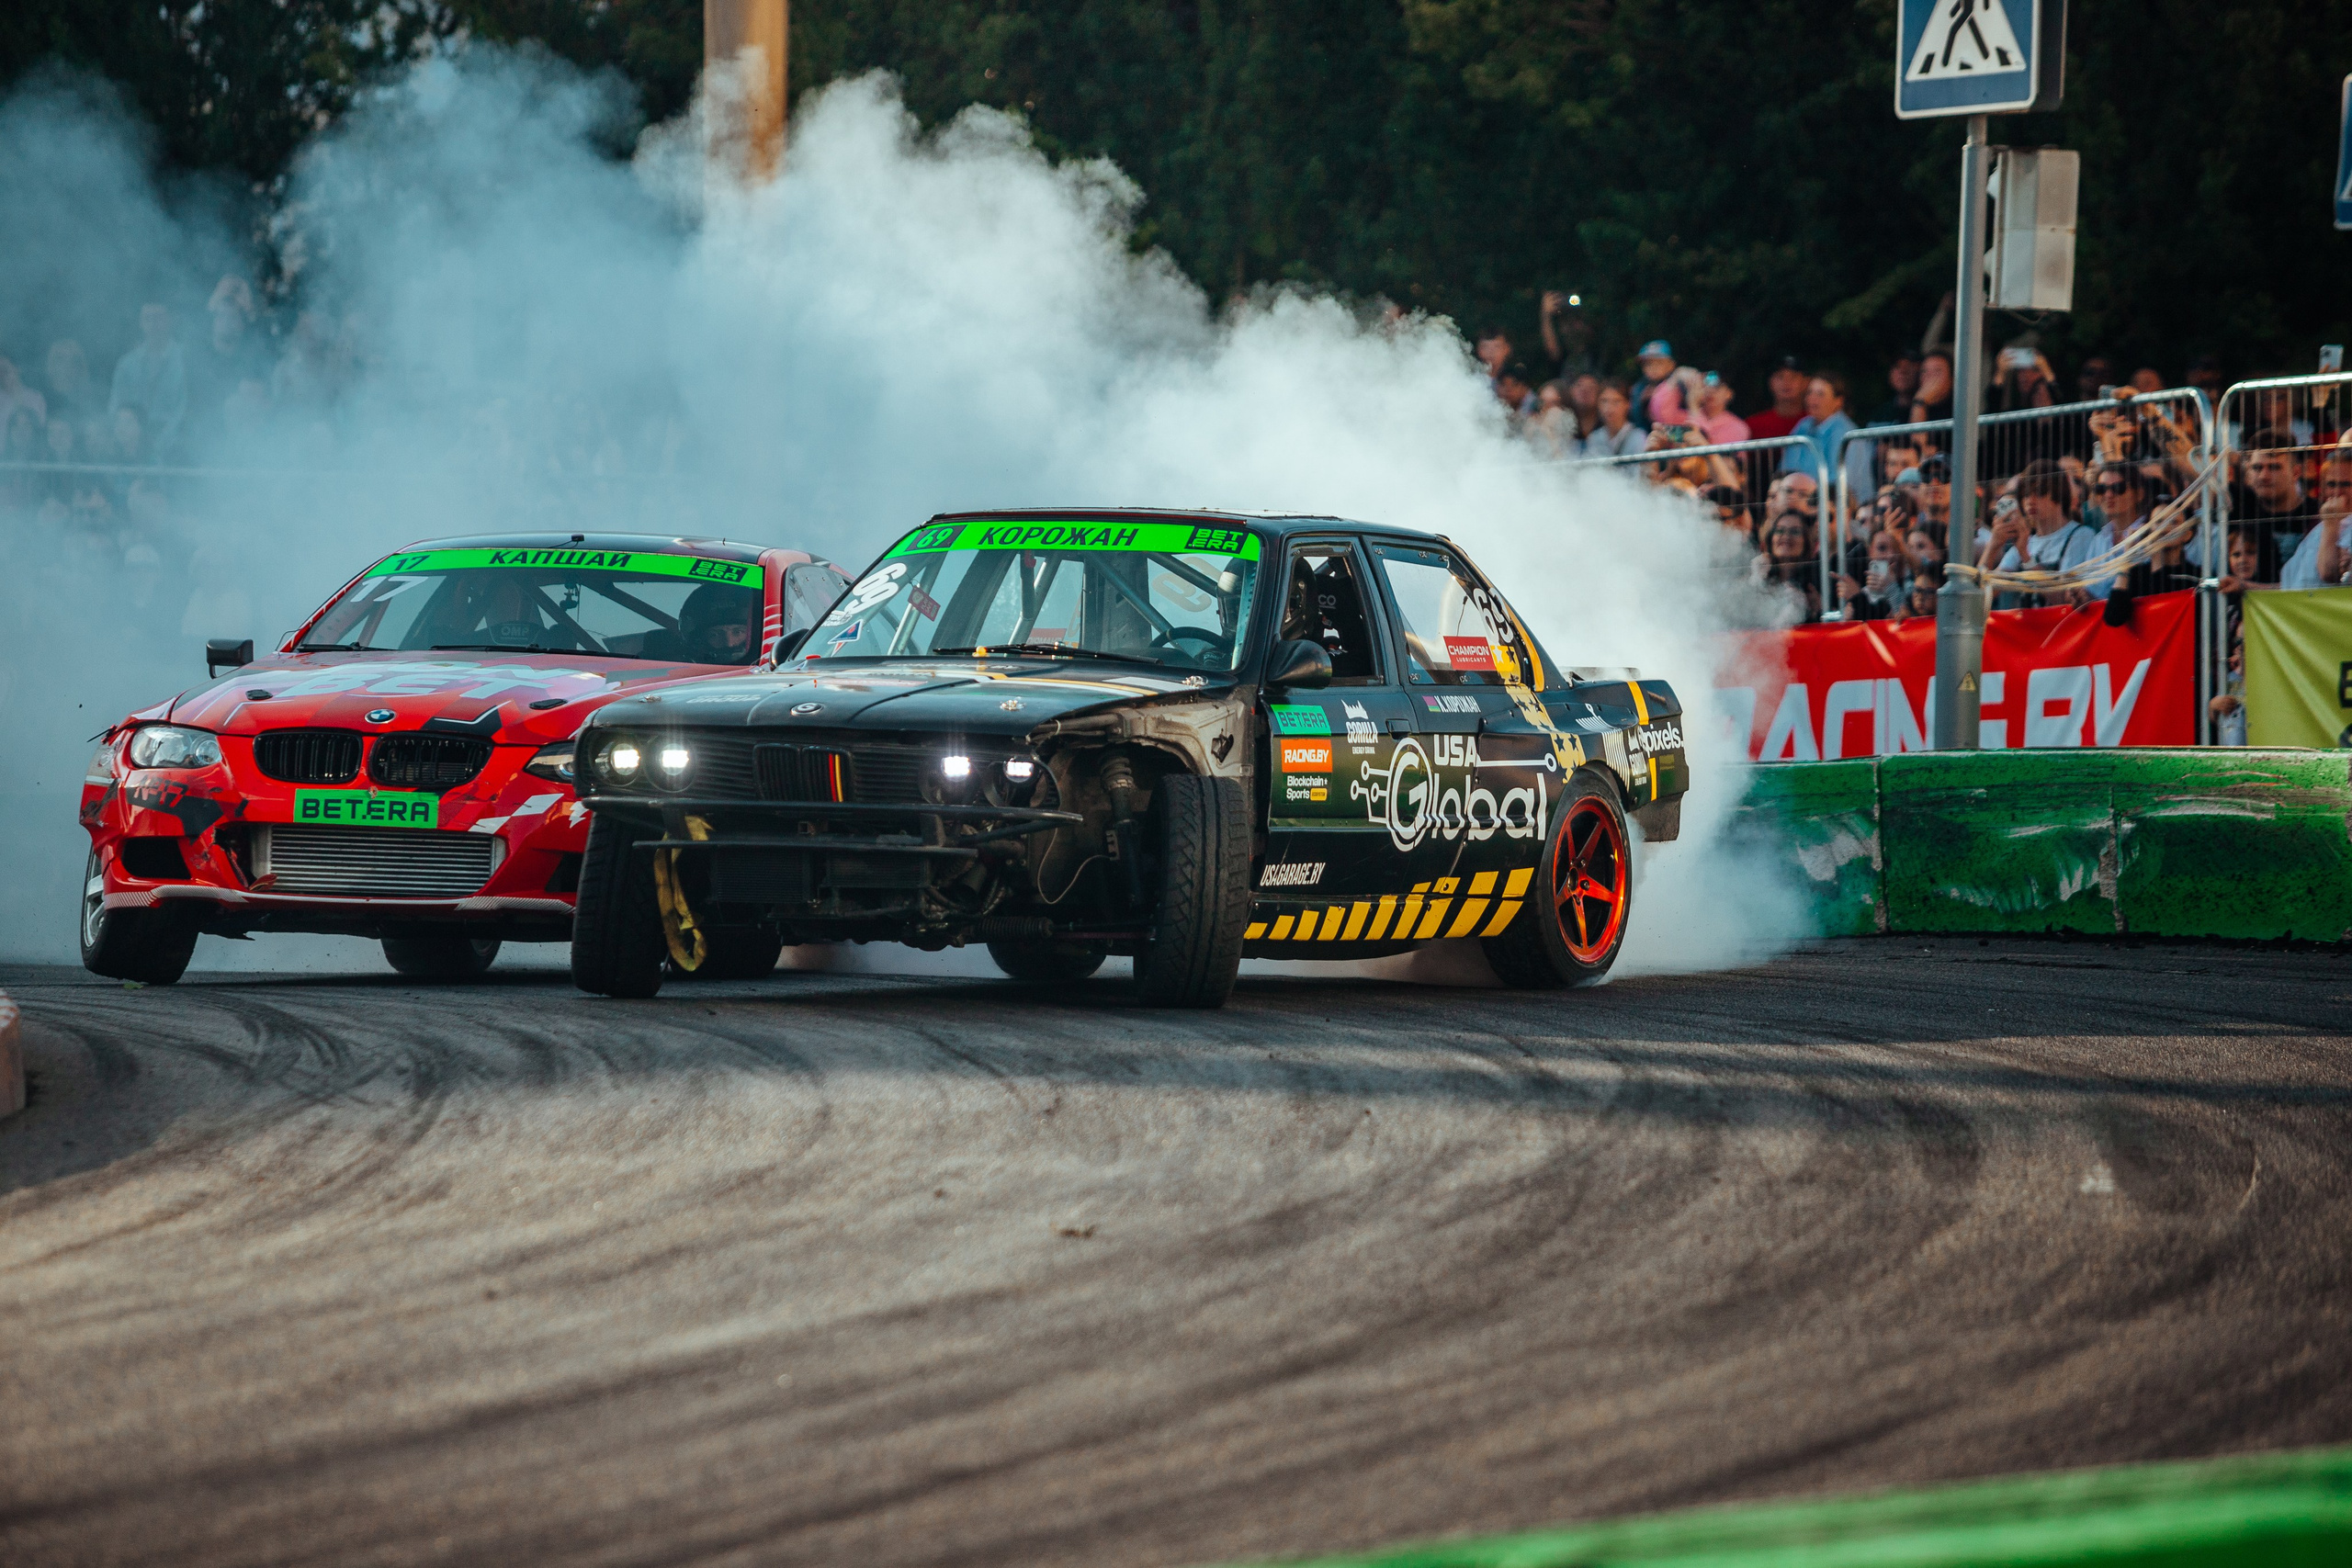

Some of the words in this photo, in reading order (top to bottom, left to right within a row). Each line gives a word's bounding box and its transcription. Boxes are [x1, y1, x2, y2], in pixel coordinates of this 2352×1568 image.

[916, 527, 954, 547] 69
[978, 526, 1139, 547] КОРОЖАН
[1194, 528, 1244, 540] BET
[394, 555, 430, 571] 17
[489, 550, 632, 569] КАПШАЙ
[697, 559, 742, 574] BET
[350, 575, 429, 603] 17
[843, 562, 908, 615] 69
[1448, 645, 1490, 656] CHAMPION
[274, 673, 554, 699] BET
[1345, 721, 1379, 744] GORILLA
[1434, 734, 1477, 768] USA
[1286, 787, 1310, 801] Sports
[1390, 750, 1547, 840] Global
[301, 798, 430, 822] BET.ERA
